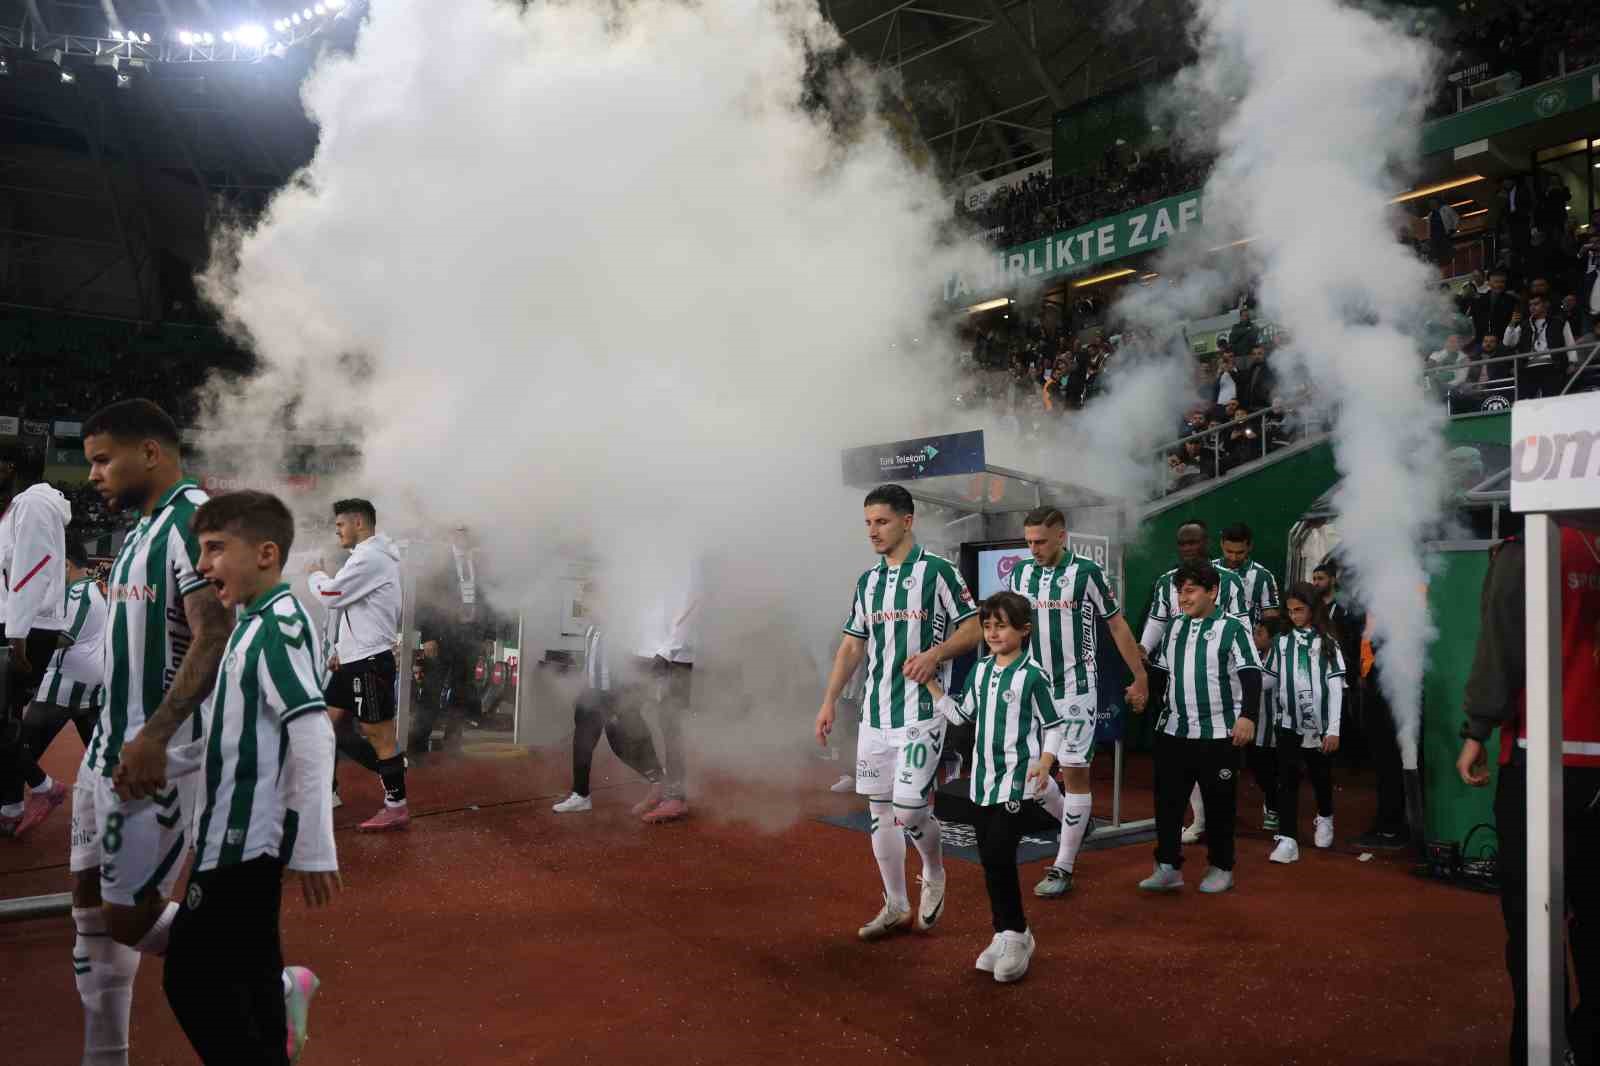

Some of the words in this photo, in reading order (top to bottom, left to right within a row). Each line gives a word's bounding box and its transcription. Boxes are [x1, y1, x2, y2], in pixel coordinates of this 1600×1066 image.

[998, 223, 1116, 279] İRLİKTE
[896, 453, 926, 464] Telekom
[1072, 543, 1104, 564] VAR
[354, 696, 363, 717] 7
[1063, 720, 1085, 740] 77
[903, 741, 928, 768] 10
[102, 811, 124, 855] 8
